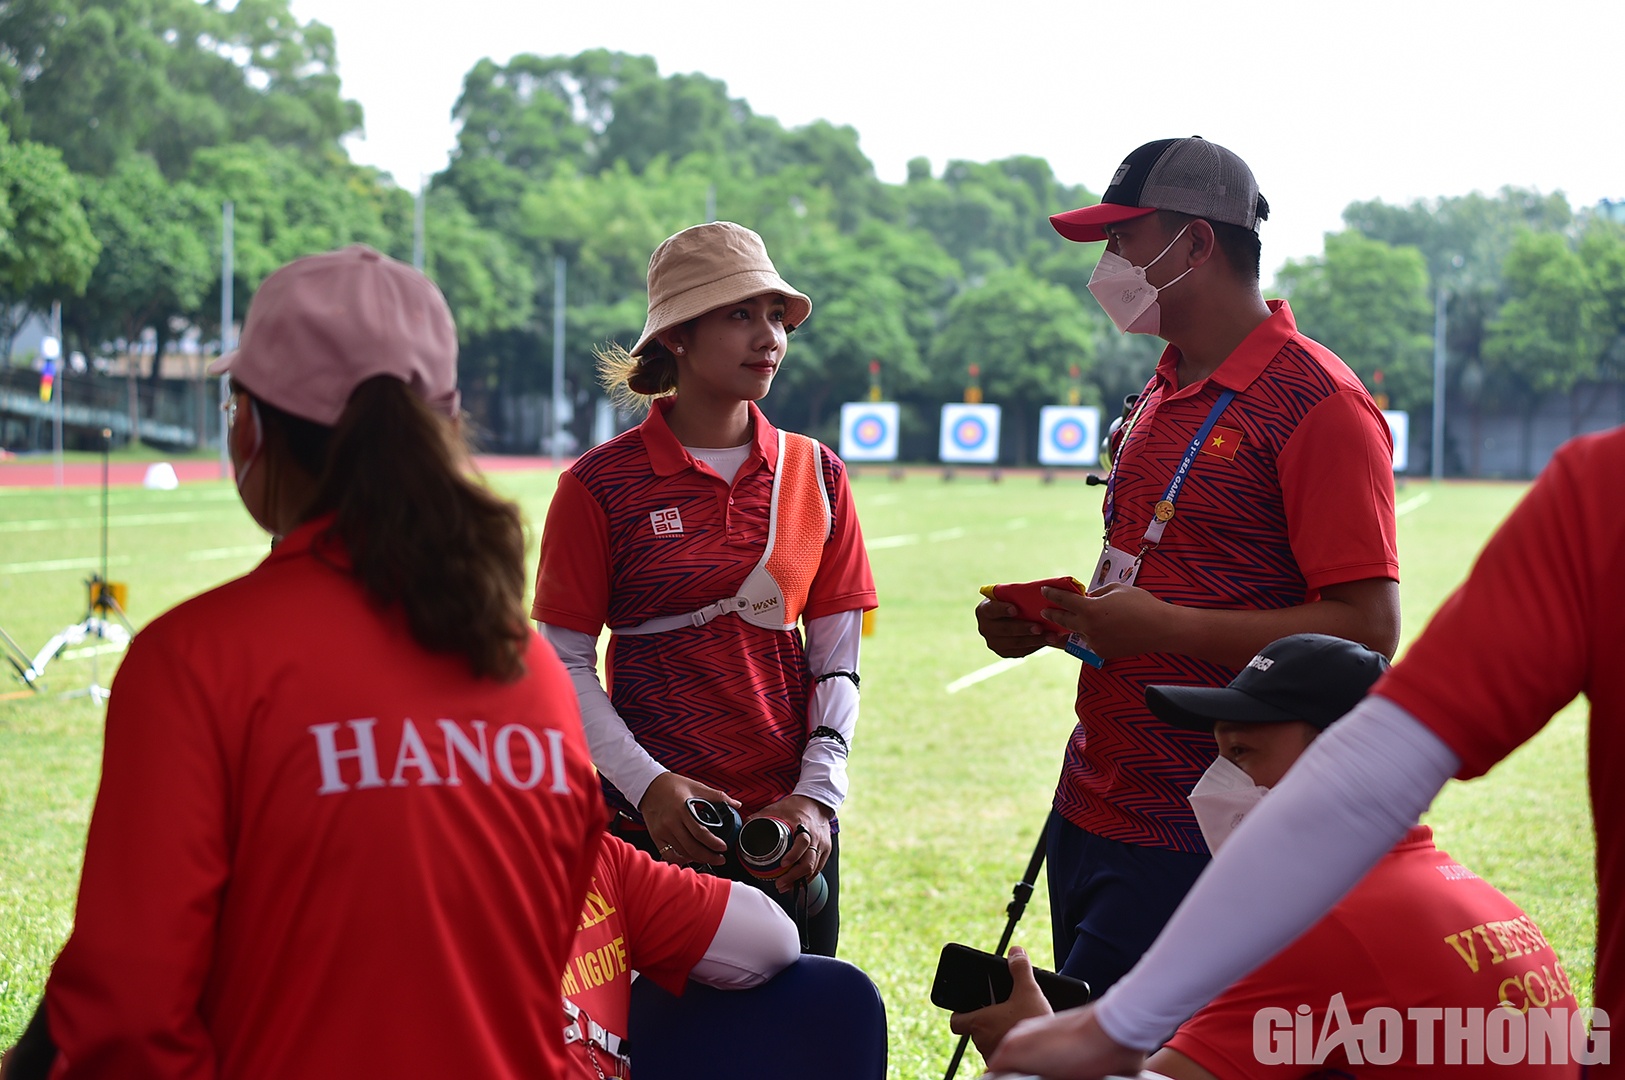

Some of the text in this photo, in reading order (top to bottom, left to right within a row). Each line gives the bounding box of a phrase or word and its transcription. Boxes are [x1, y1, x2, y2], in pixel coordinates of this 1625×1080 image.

[1179, 457, 1191, 474] SEA
[752, 597, 778, 611] W&W
[307, 717, 572, 796] HANOI
